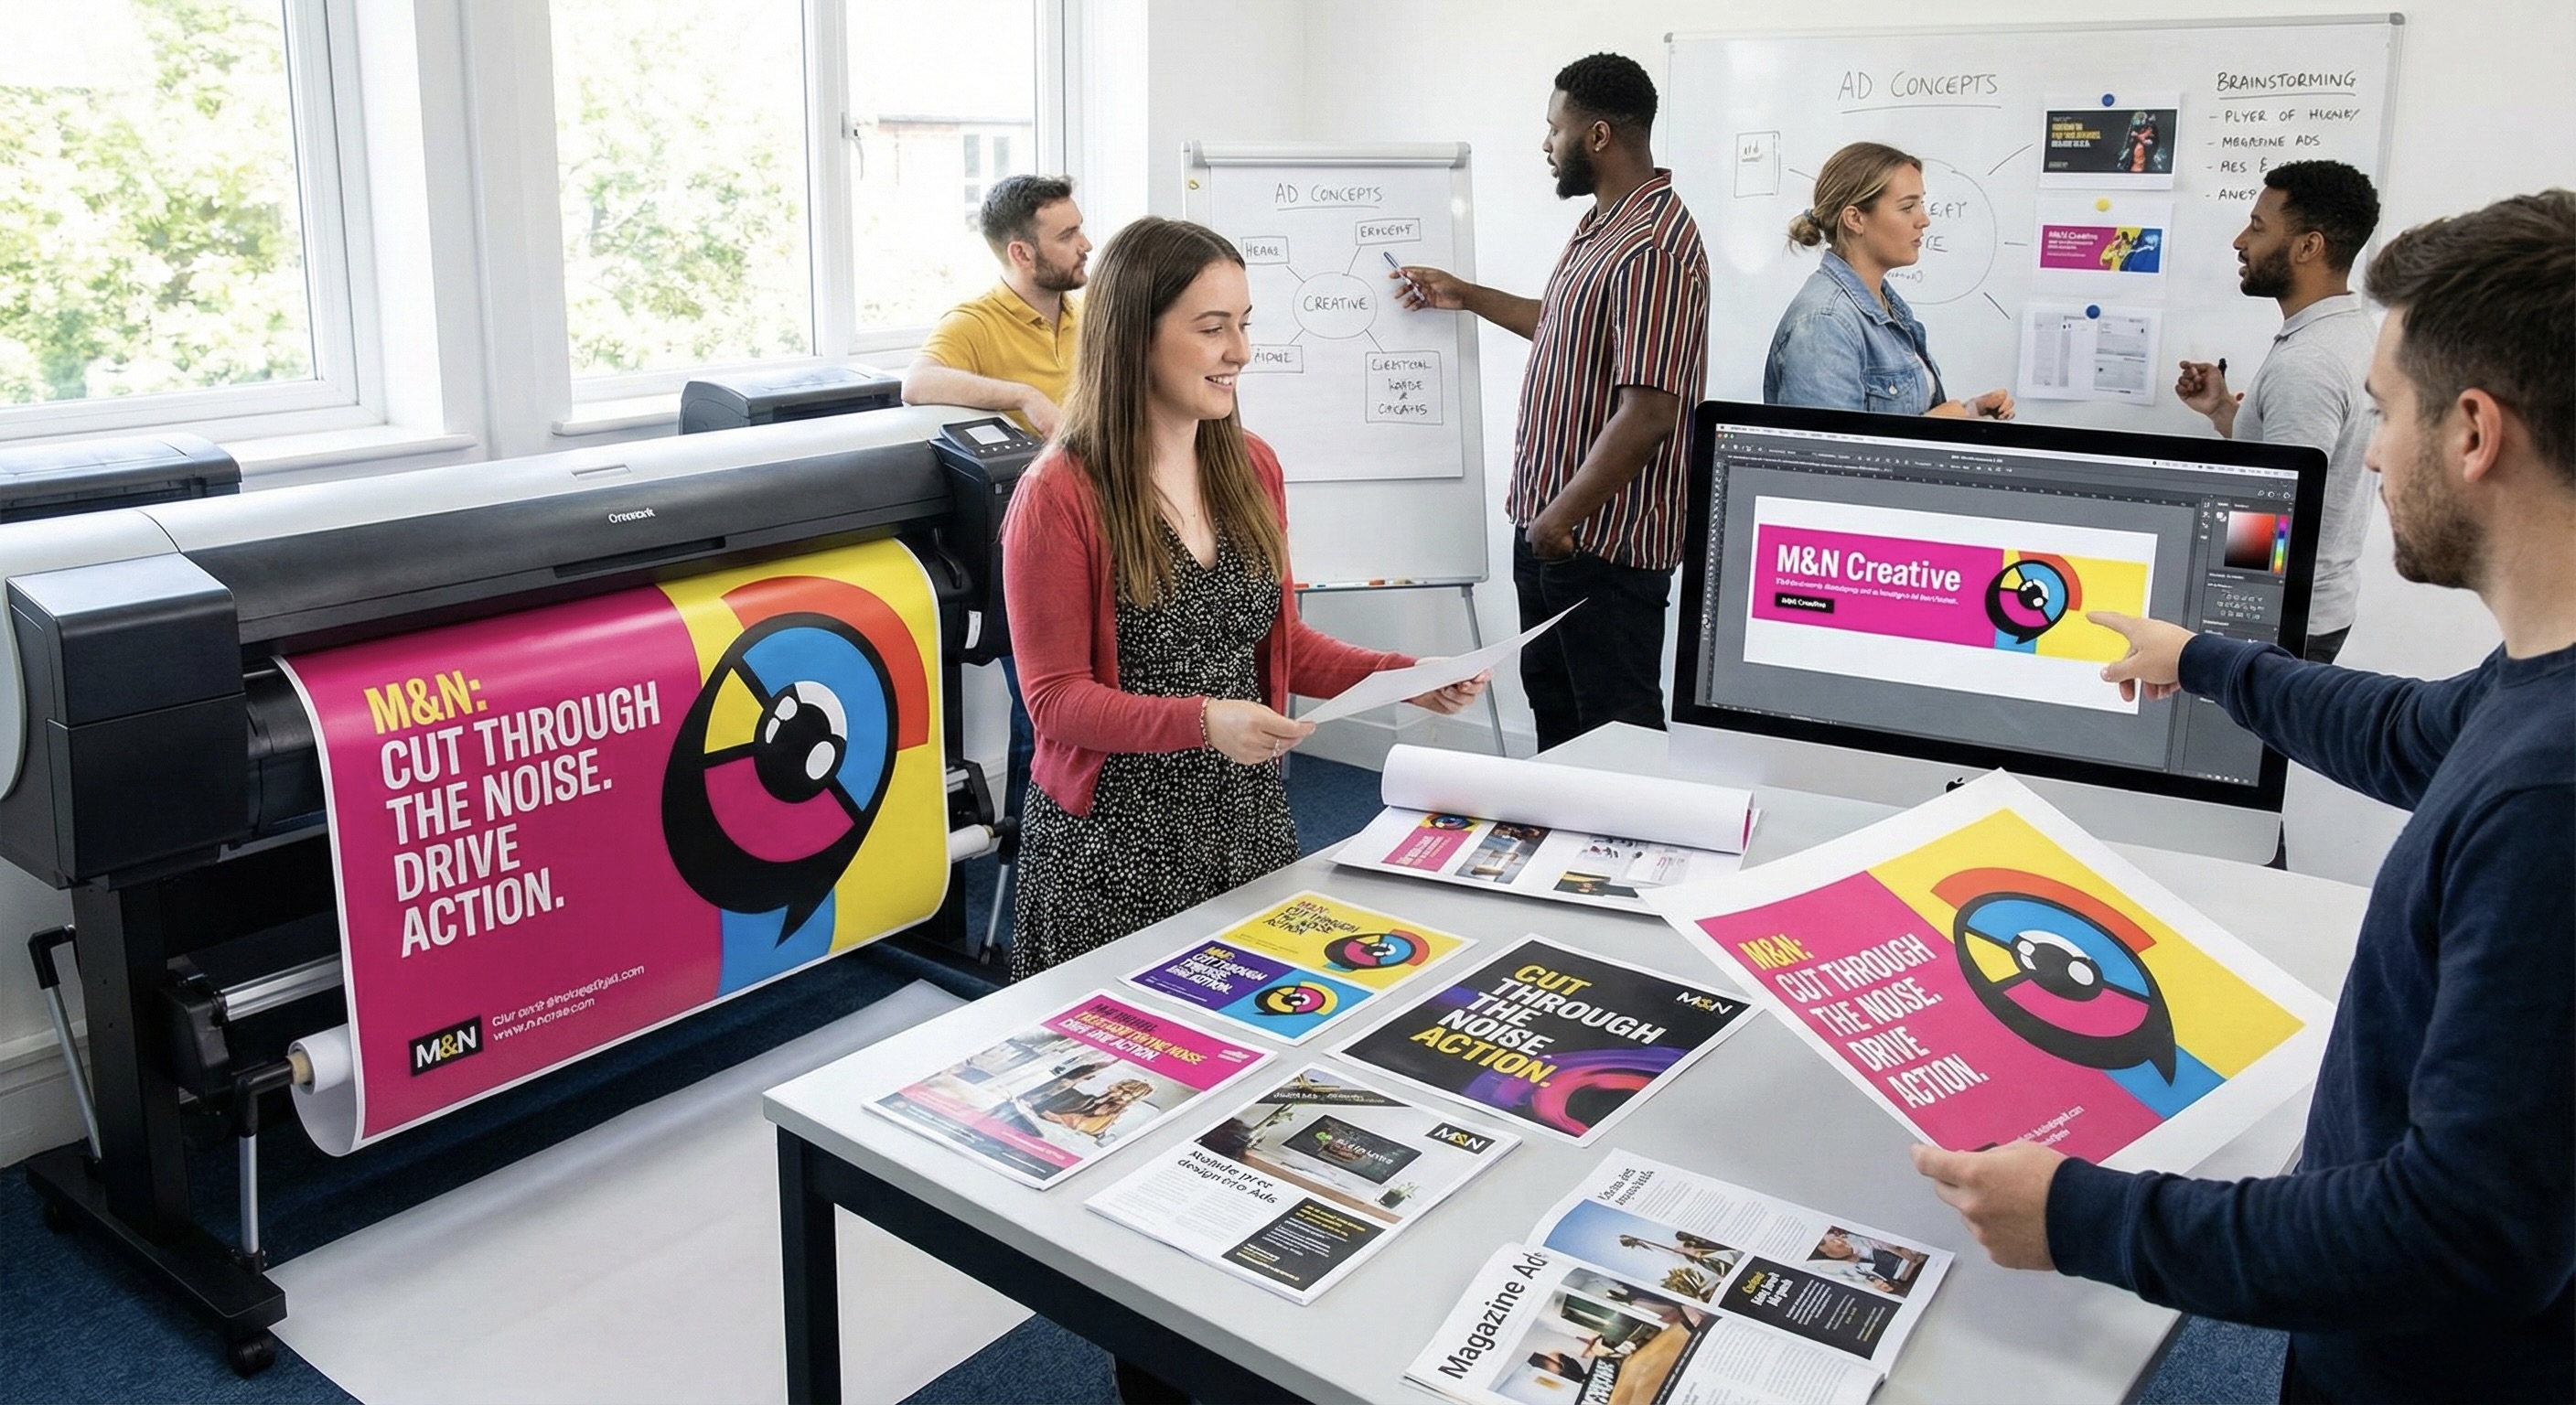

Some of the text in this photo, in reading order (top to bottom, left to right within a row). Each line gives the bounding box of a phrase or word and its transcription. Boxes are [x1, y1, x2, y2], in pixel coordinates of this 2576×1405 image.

[1837, 70, 1999, 102] AD CONCEPTS
[2216, 70, 2356, 91] BRAINSTORMING
[2295, 134, 2321, 146] ADS
[1275, 183, 1383, 204] AD CONCEPTS
[1304, 295, 1368, 312] CREATIVE
[1777, 545, 1840, 579] M&N
[1846, 552, 1961, 592] Creative
[365, 670, 488, 735] M&N:
[381, 681, 660, 790] CUT THROUGH
[386, 749, 613, 846] THE NOISE.
[394, 824, 521, 903] DRIVE
[401, 867, 565, 959] ACTION.
[1739, 933, 1813, 971] M&N:
[1774, 933, 1937, 1004] CUT THROUGH
[1514, 964, 1592, 996] CUT
[1675, 991, 1733, 1015] M&N
[1466, 992, 1543, 1028] THE
[1491, 977, 1668, 1045] THROUGH
[1809, 973, 1943, 1042] THE NOISE.
[415, 1026, 478, 1068] M&N
[1410, 1026, 1558, 1088] ACTION.
[1848, 1026, 1930, 1072] DRIVE
[1887, 1053, 1989, 1109] ACTION.
[1437, 1281, 1526, 1379] Magazine
